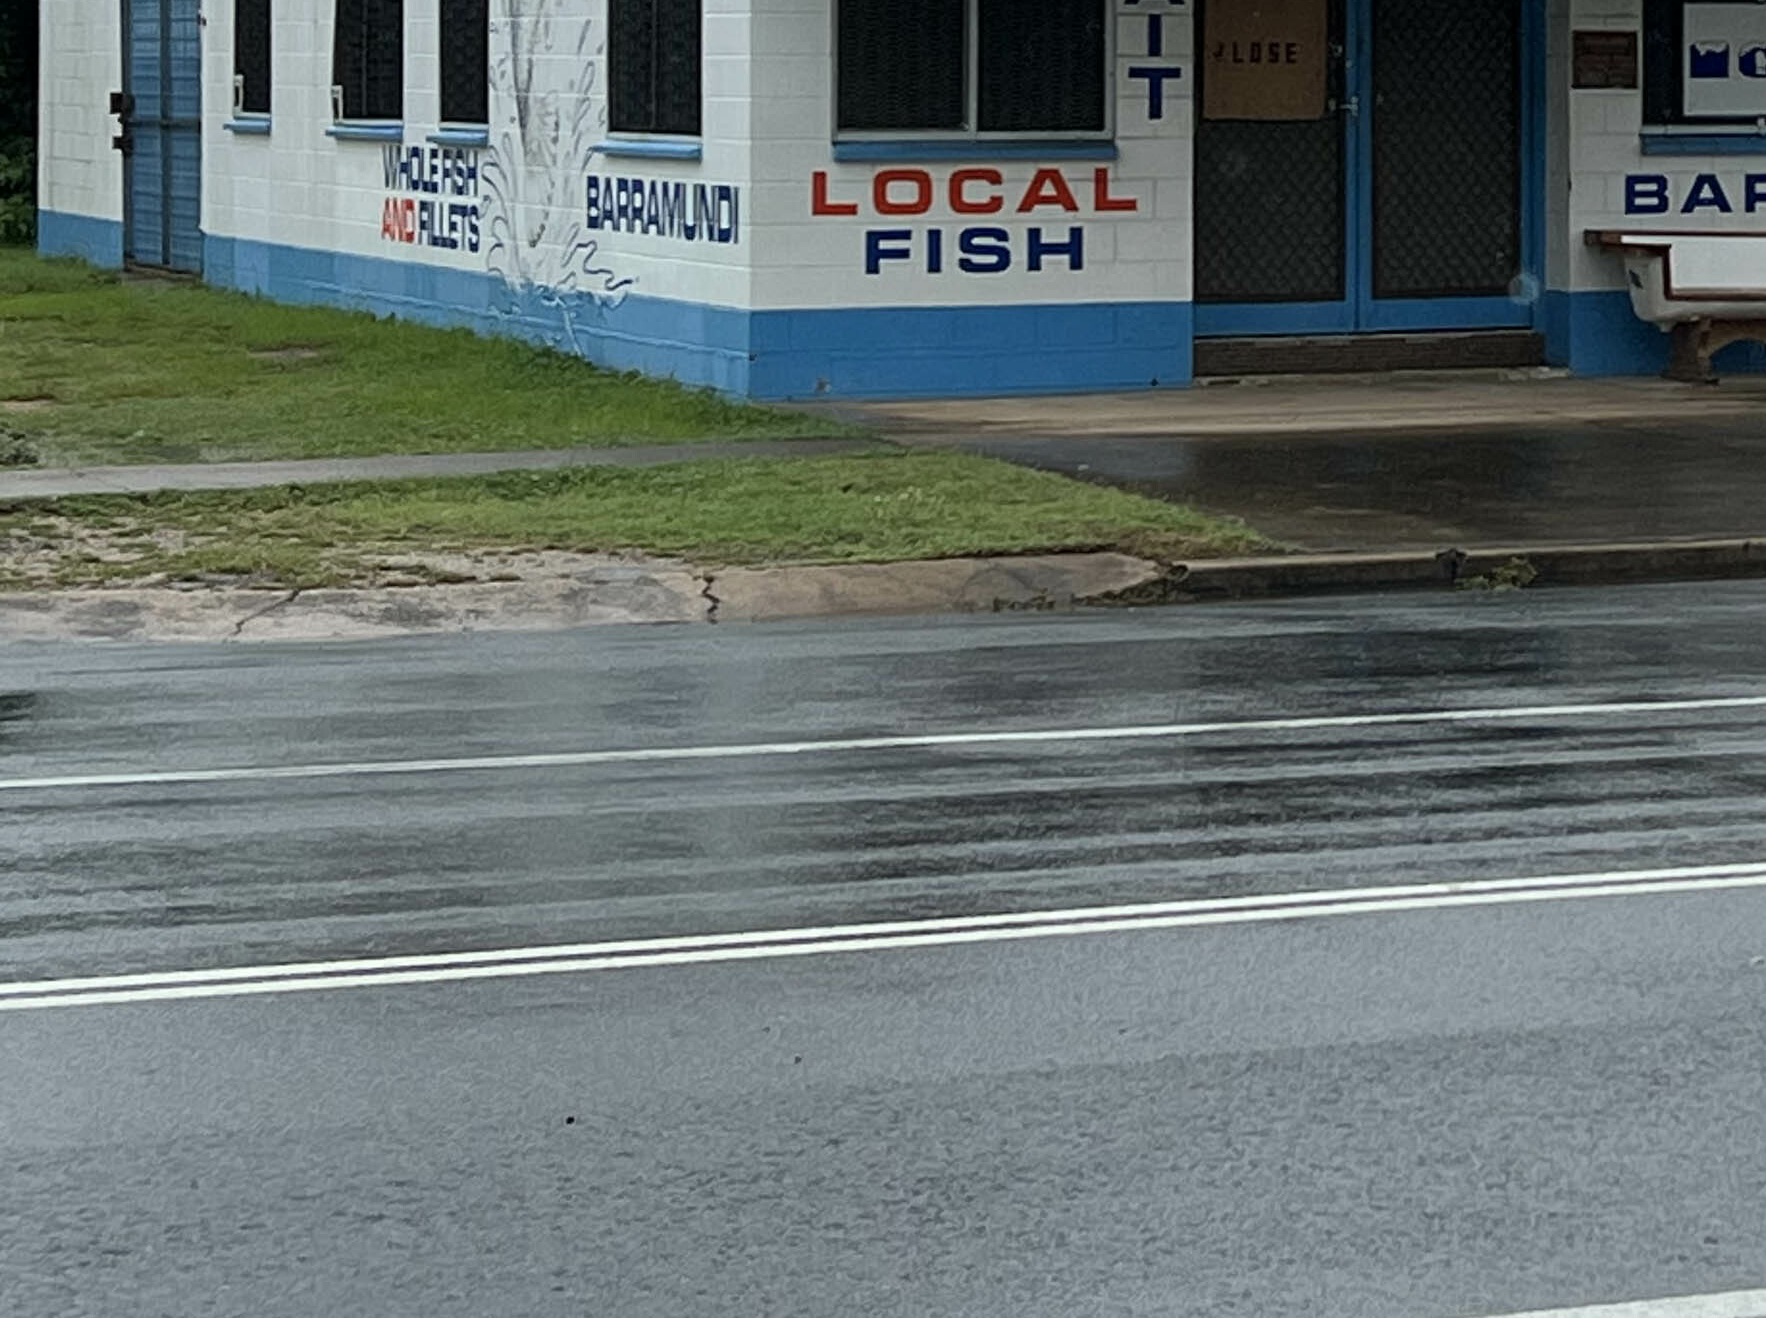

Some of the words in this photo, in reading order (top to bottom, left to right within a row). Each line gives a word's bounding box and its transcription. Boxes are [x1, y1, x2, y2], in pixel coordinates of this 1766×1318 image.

[382, 144, 438, 194] WHOLE
[443, 147, 479, 197] FISH
[811, 168, 1138, 216] LOCAL
[381, 197, 416, 244] AND
[418, 200, 480, 254] FILLETS
[586, 175, 739, 244] BARRAMUNDI
[864, 227, 1084, 275] FISH
